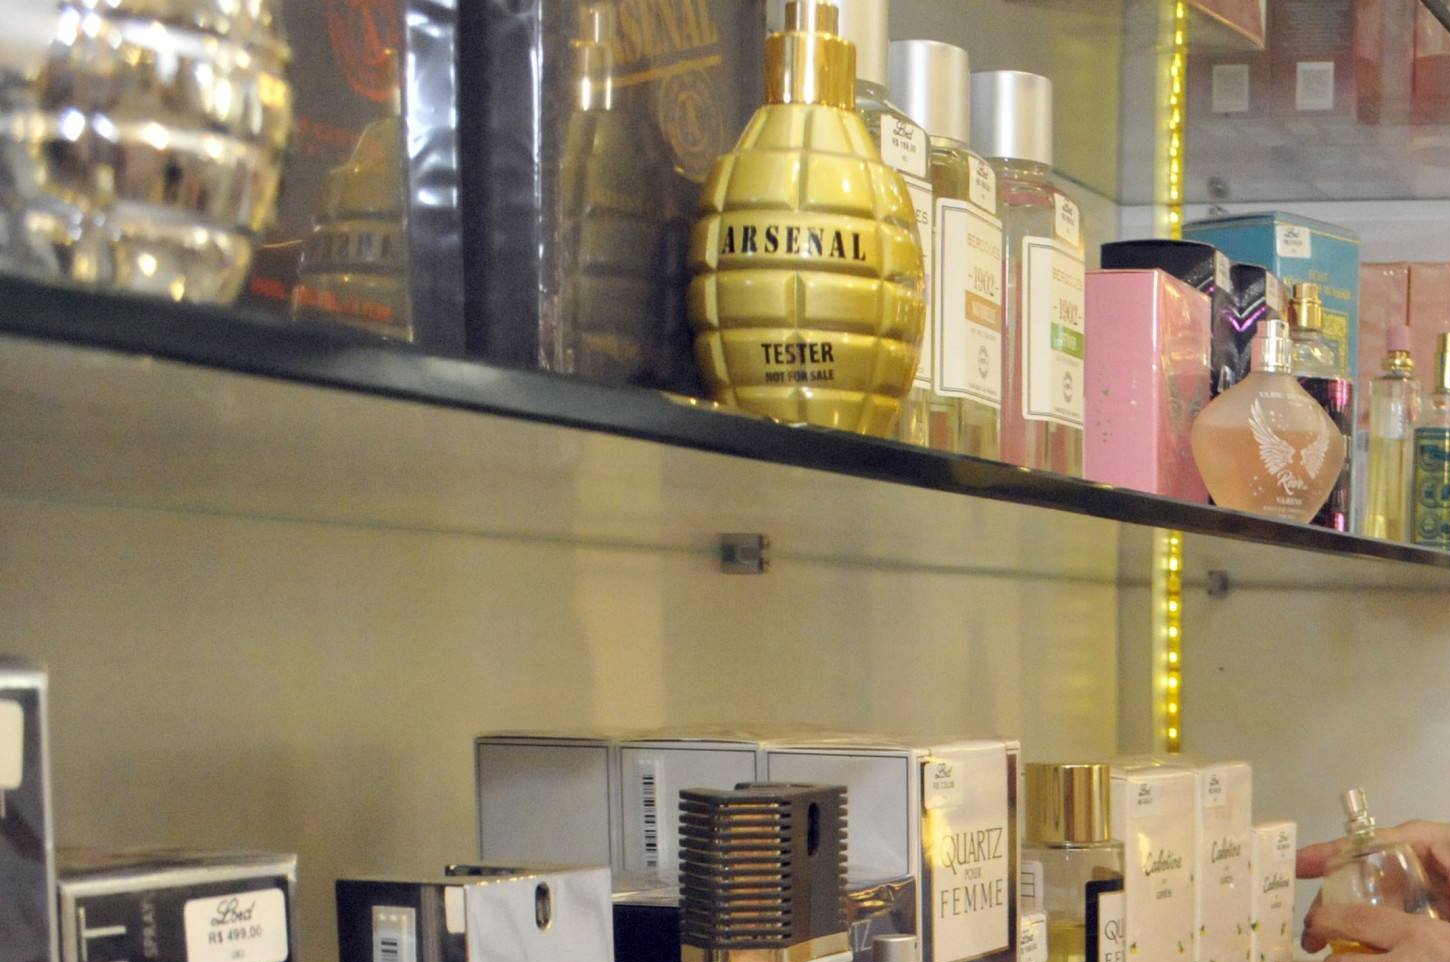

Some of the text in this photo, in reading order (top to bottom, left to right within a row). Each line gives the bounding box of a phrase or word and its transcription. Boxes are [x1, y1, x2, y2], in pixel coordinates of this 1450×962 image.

[720, 224, 867, 262] ARSENAL
[761, 342, 835, 365] TESTER
[765, 369, 835, 383] NOT FOR SALE
[941, 827, 1003, 875] QUARTZ
[940, 878, 1004, 919] FEMME
[208, 924, 263, 945] R$ 499,00
